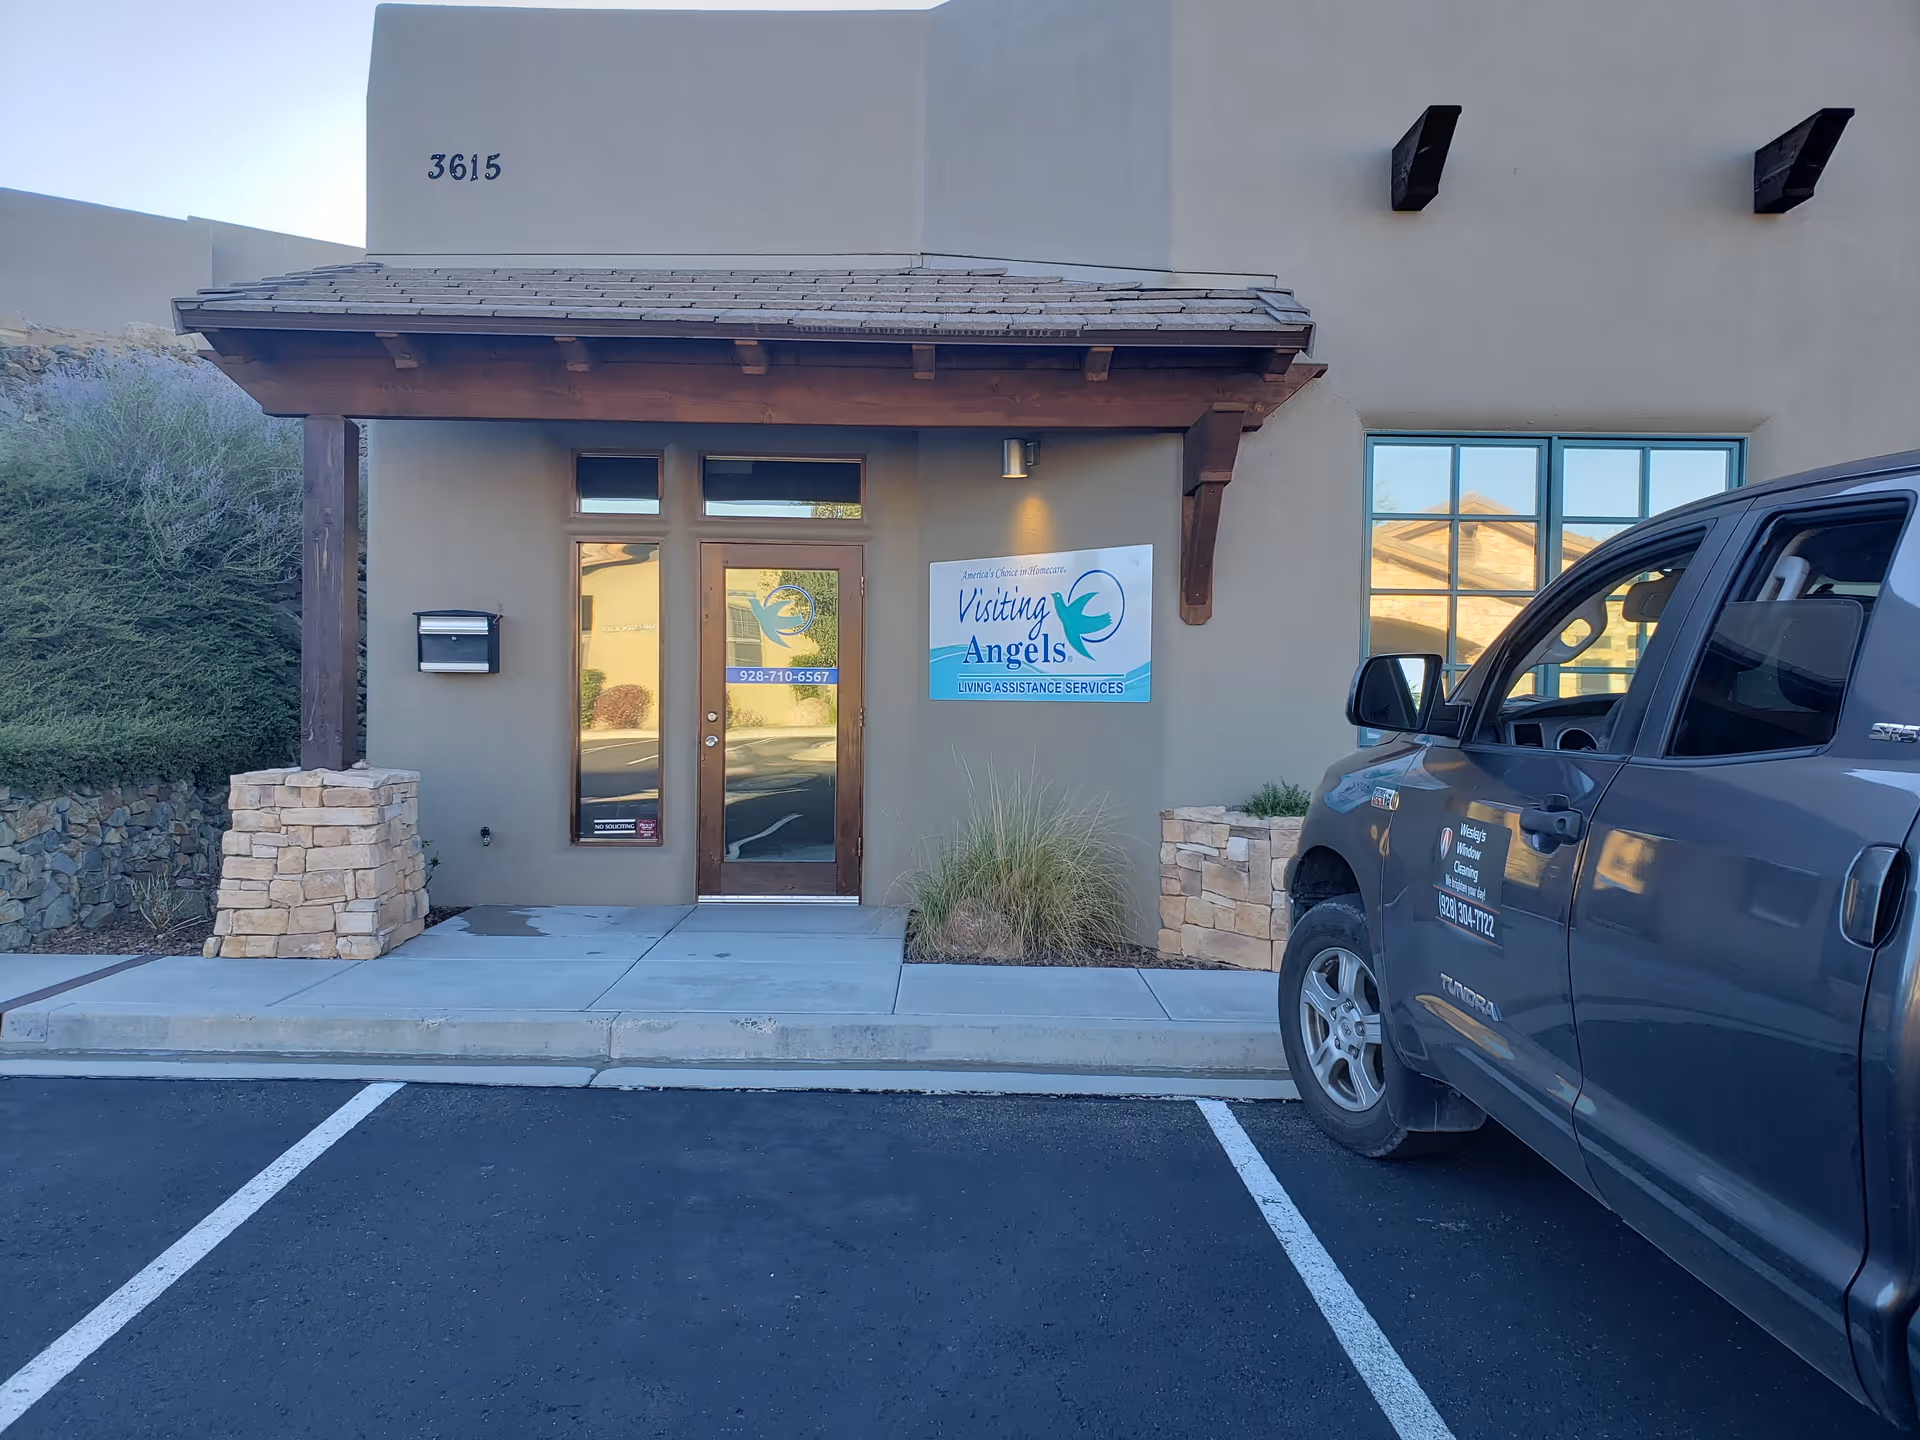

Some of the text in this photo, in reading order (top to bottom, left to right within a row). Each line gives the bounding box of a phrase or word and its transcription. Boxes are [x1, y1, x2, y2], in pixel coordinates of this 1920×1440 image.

[428, 152, 502, 182] 3615
[961, 568, 995, 582] America's
[995, 567, 1018, 579] Choice
[1019, 566, 1028, 577] in
[958, 585, 1051, 640] Visiting
[739, 670, 830, 683] 928-710-6567
[958, 681, 1124, 695] LIVING ASSISTANCE SERVICES
[1459, 822, 1487, 844] Wesley's
[1456, 841, 1482, 861] Window
[1453, 860, 1479, 883] Cleaning
[1445, 873, 1486, 902] We brighten your day!
[1438, 890, 1495, 938] (928) 304-7722
[1440, 972, 1502, 1022] TUNDRA
